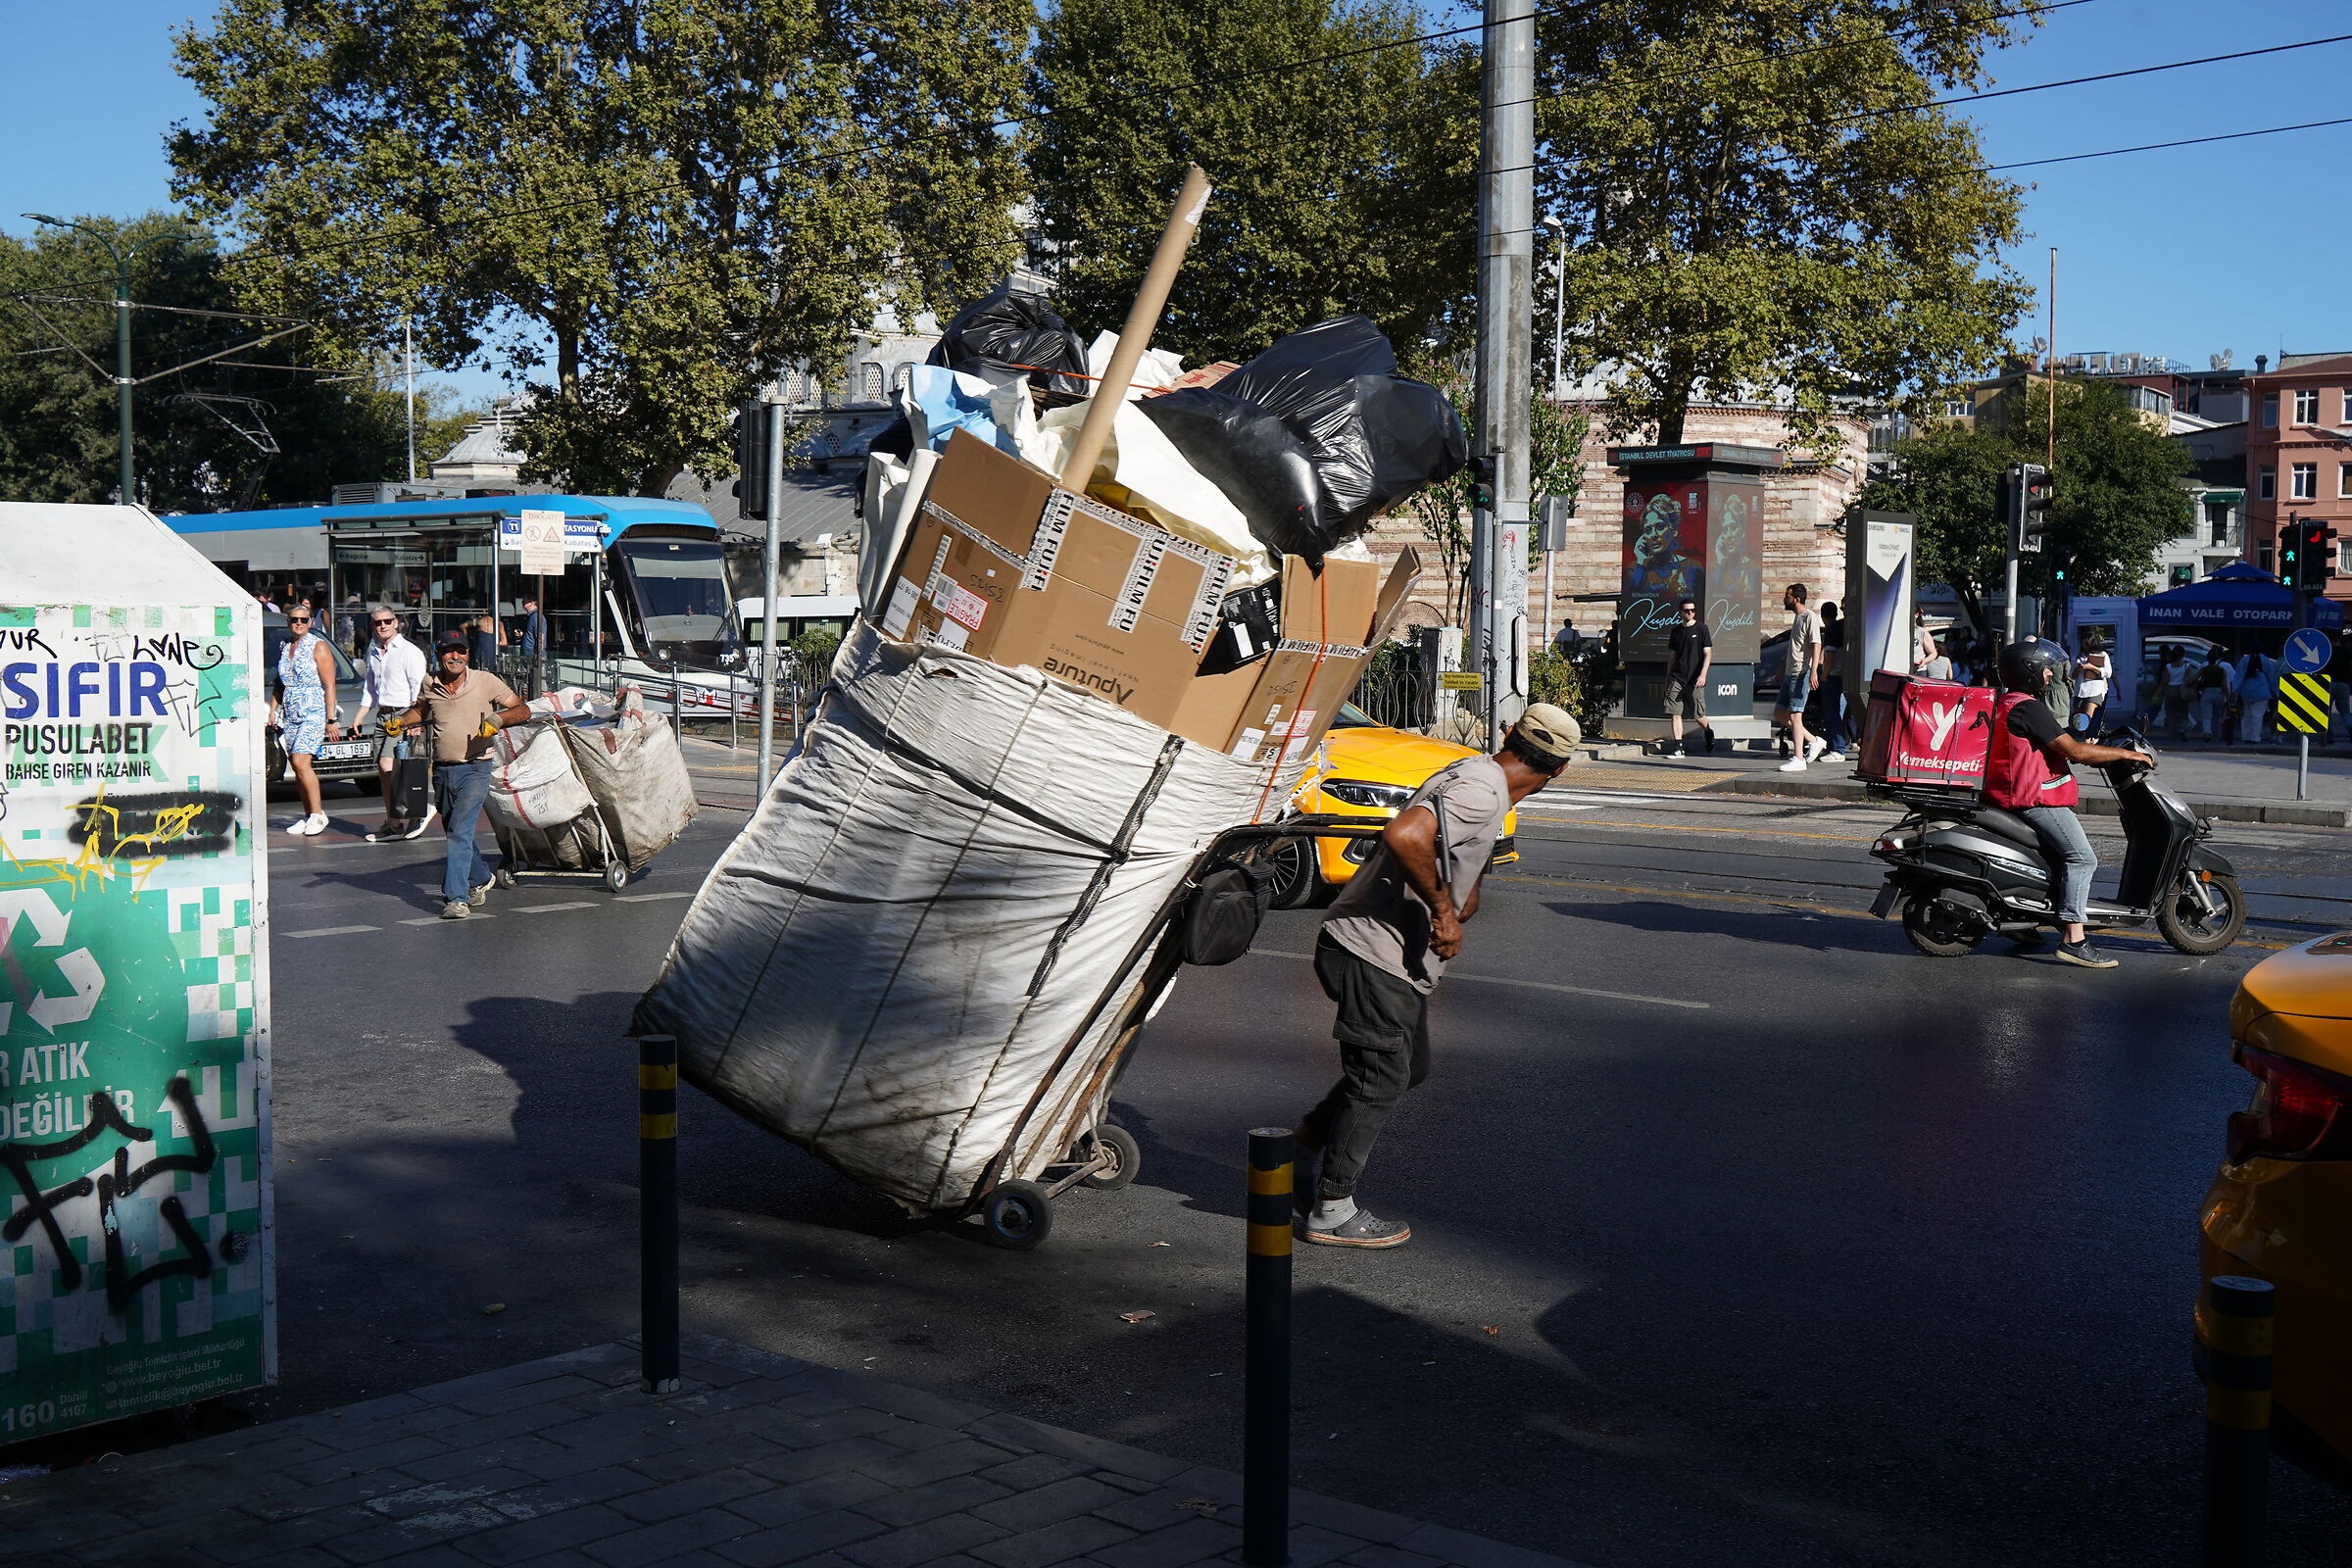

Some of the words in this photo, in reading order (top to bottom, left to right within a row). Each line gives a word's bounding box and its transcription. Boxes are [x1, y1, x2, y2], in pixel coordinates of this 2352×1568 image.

[1619, 450, 1644, 461] İSTANBUL
[1645, 449, 1666, 460] DEVLET
[1667, 448, 1695, 459] TİYATROSU
[564, 524, 598, 533] TASYONU
[948, 602, 981, 628] FRAGILE
[1119, 608, 1138, 633] FU
[1624, 598, 1684, 639] Kuşdi
[2149, 606, 2182, 618] İNAN
[2190, 608, 2226, 619] VALE
[719, 653, 735, 663] 735
[1088, 659, 1114, 673] Level
[1042, 656, 1135, 705] Aputure
[1116, 669, 1140, 683] Next
[4, 662, 170, 720] SIFIR
[5, 722, 153, 755] PUSULABET
[322, 745, 333, 757] 34
[335, 746, 346, 756] GL
[350, 744, 369, 754] 1697
[5, 762, 50, 780] BAHSE
[53, 762, 92, 779] GIREN
[96, 760, 152, 779] KAZANIR
[1896, 750, 1983, 773] Yemeksepeti
[20, 1041, 91, 1086] ATIK
[60, 1390, 88, 1404] Dahili
[60, 1402, 88, 1420] 4107
